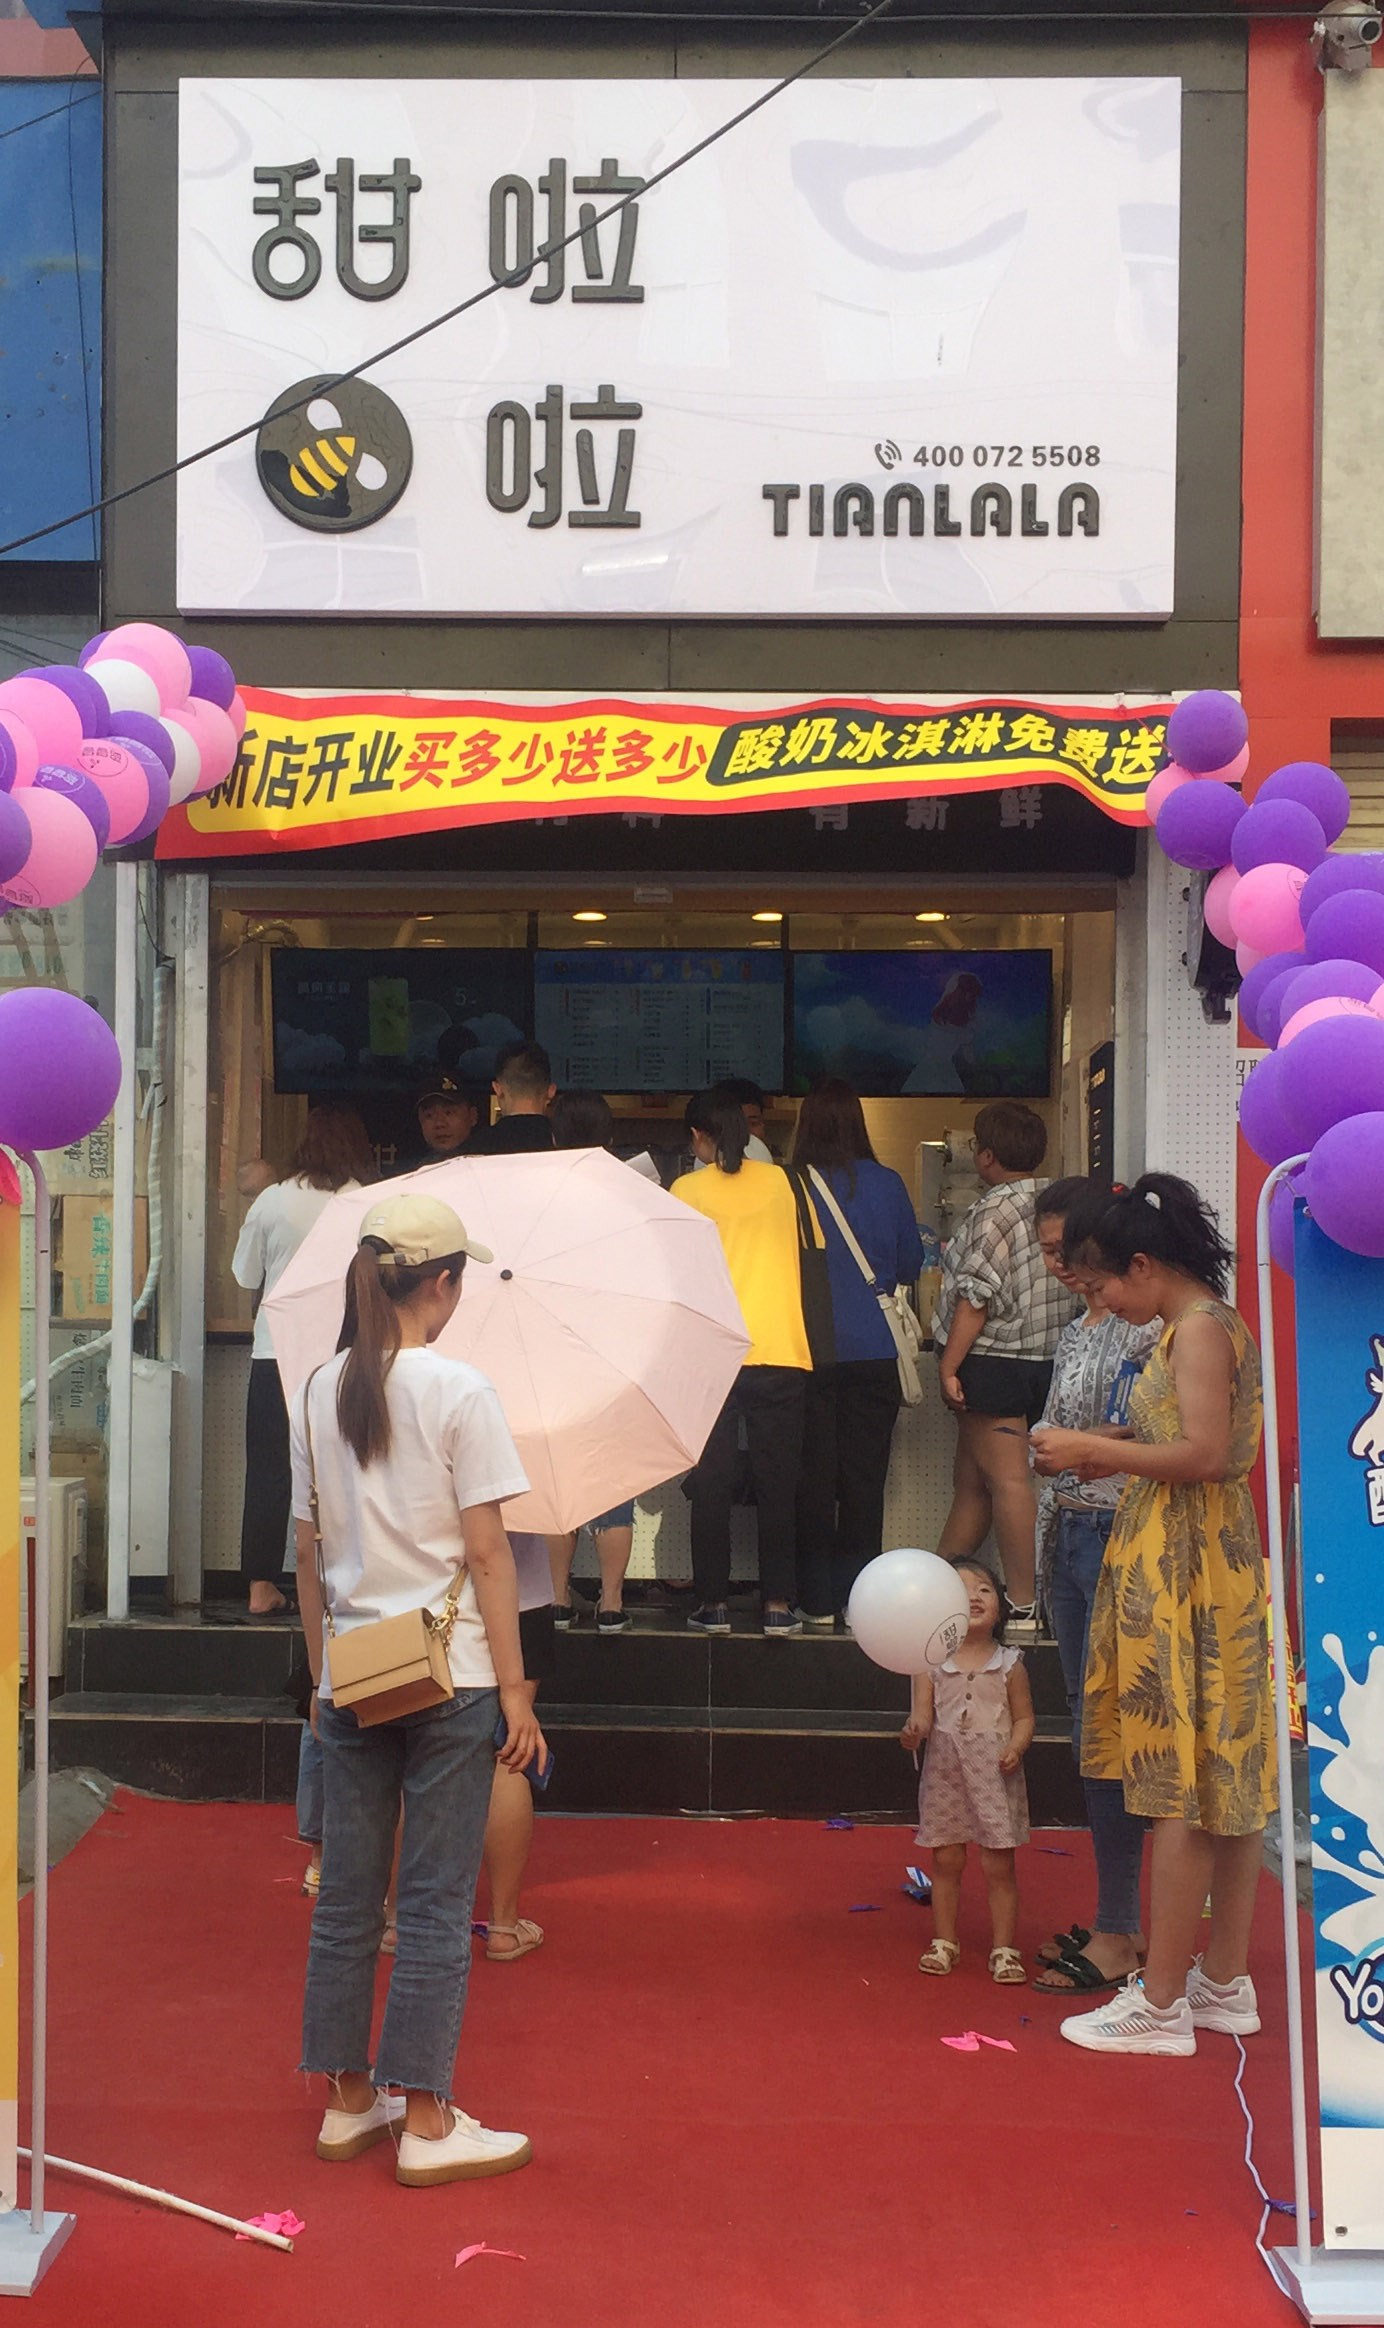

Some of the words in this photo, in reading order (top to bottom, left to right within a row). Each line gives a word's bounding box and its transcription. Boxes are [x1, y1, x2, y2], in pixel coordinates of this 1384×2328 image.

[486, 384, 643, 529] 啦
[913, 445, 964, 467] 400
[972, 445, 1023, 467] 072
[1031, 445, 1101, 467] 5508
[762, 482, 1101, 537] TIANLALA
